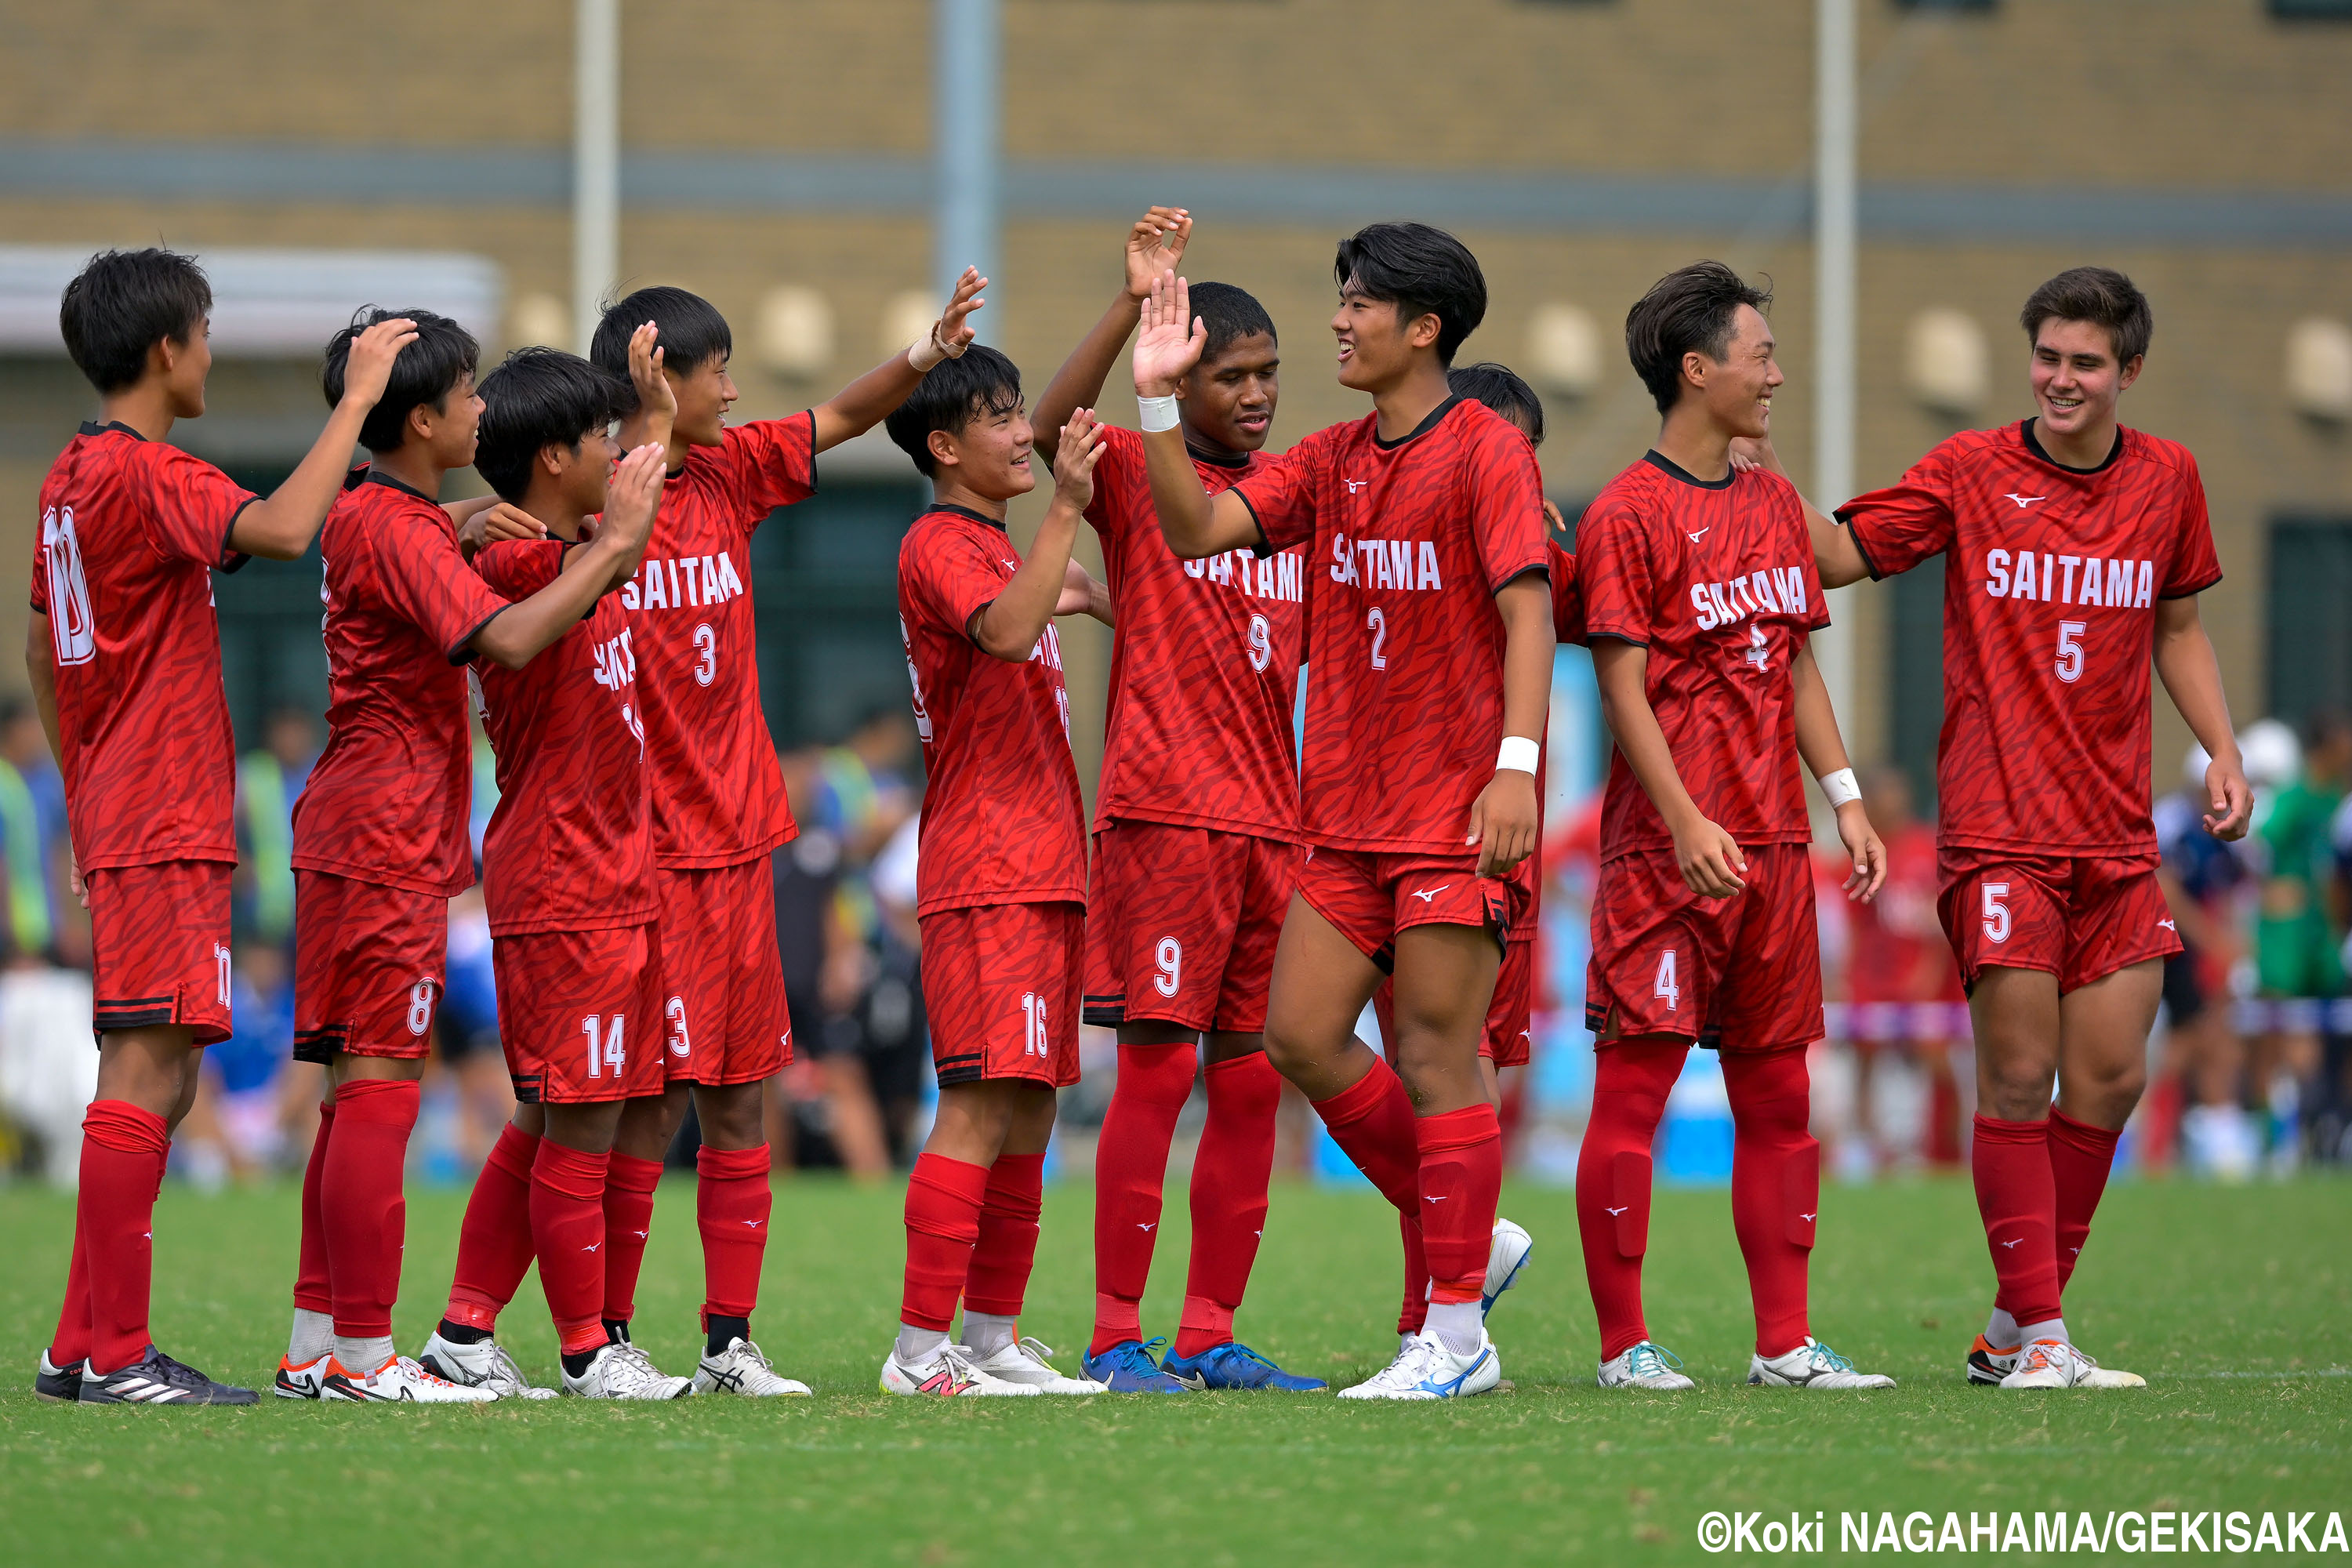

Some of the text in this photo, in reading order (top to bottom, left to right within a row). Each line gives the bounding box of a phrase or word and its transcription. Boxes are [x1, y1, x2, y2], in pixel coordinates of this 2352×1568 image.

[1690, 566, 1807, 630] SAITAMA
[1987, 549, 2153, 608] SAITAMA
[692, 623, 717, 687] 3
[1247, 613, 1271, 673] 9
[1367, 607, 1387, 671] 2
[1745, 623, 1769, 673] 4
[2054, 619, 2087, 683] 5
[1981, 882, 2012, 944] 5
[1154, 936, 1182, 998] 9
[1653, 949, 1679, 1011] 4
[407, 977, 436, 1036] 8
[666, 996, 691, 1058] 3
[1022, 992, 1048, 1058] 16
[583, 1014, 626, 1079] 14
